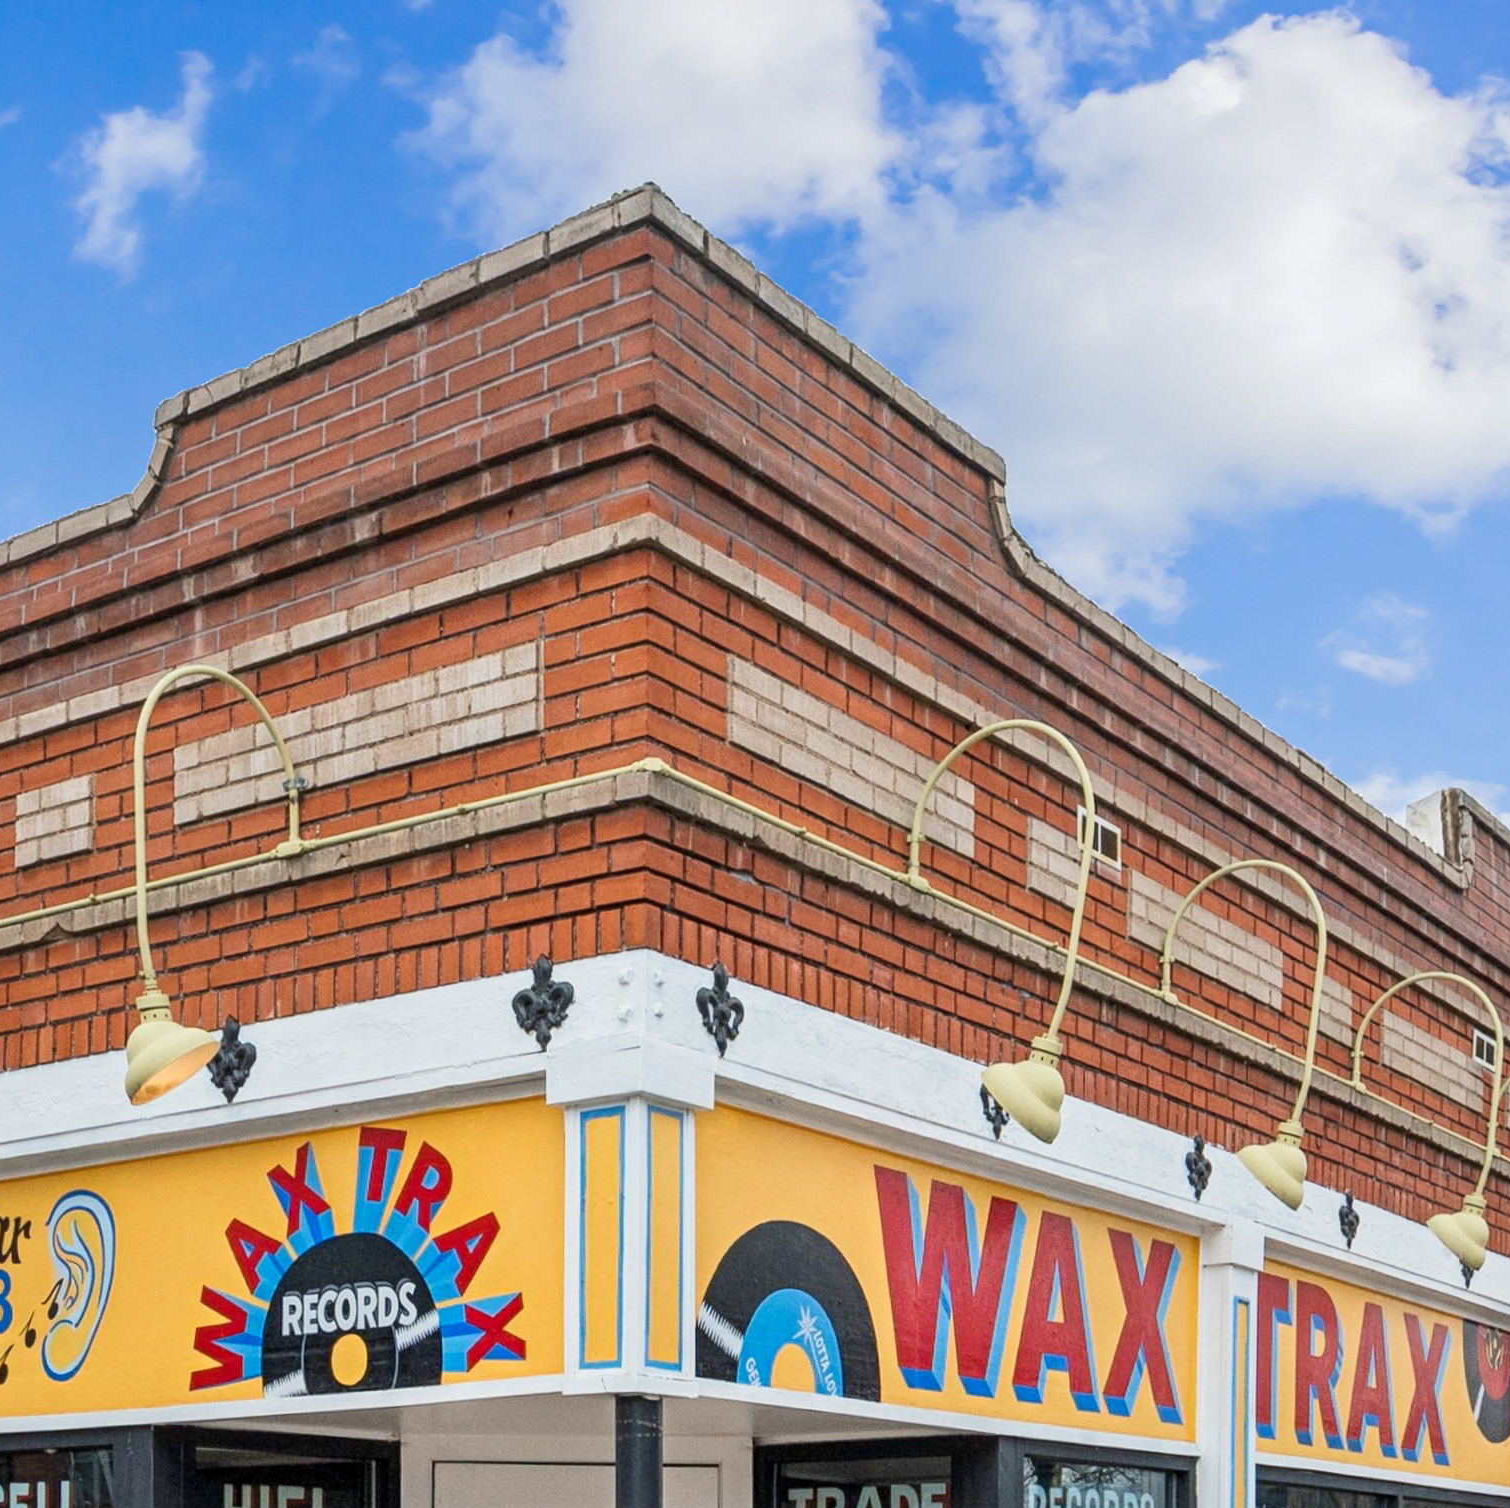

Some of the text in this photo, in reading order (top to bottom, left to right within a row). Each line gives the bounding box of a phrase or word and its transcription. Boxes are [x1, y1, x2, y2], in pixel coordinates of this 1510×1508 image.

[281, 1281, 418, 1336] RECORDS
[813, 1331, 831, 1373] LOTTA
[874, 1165, 1182, 1425] WAX
[1257, 1272, 1451, 1466] TRAX
